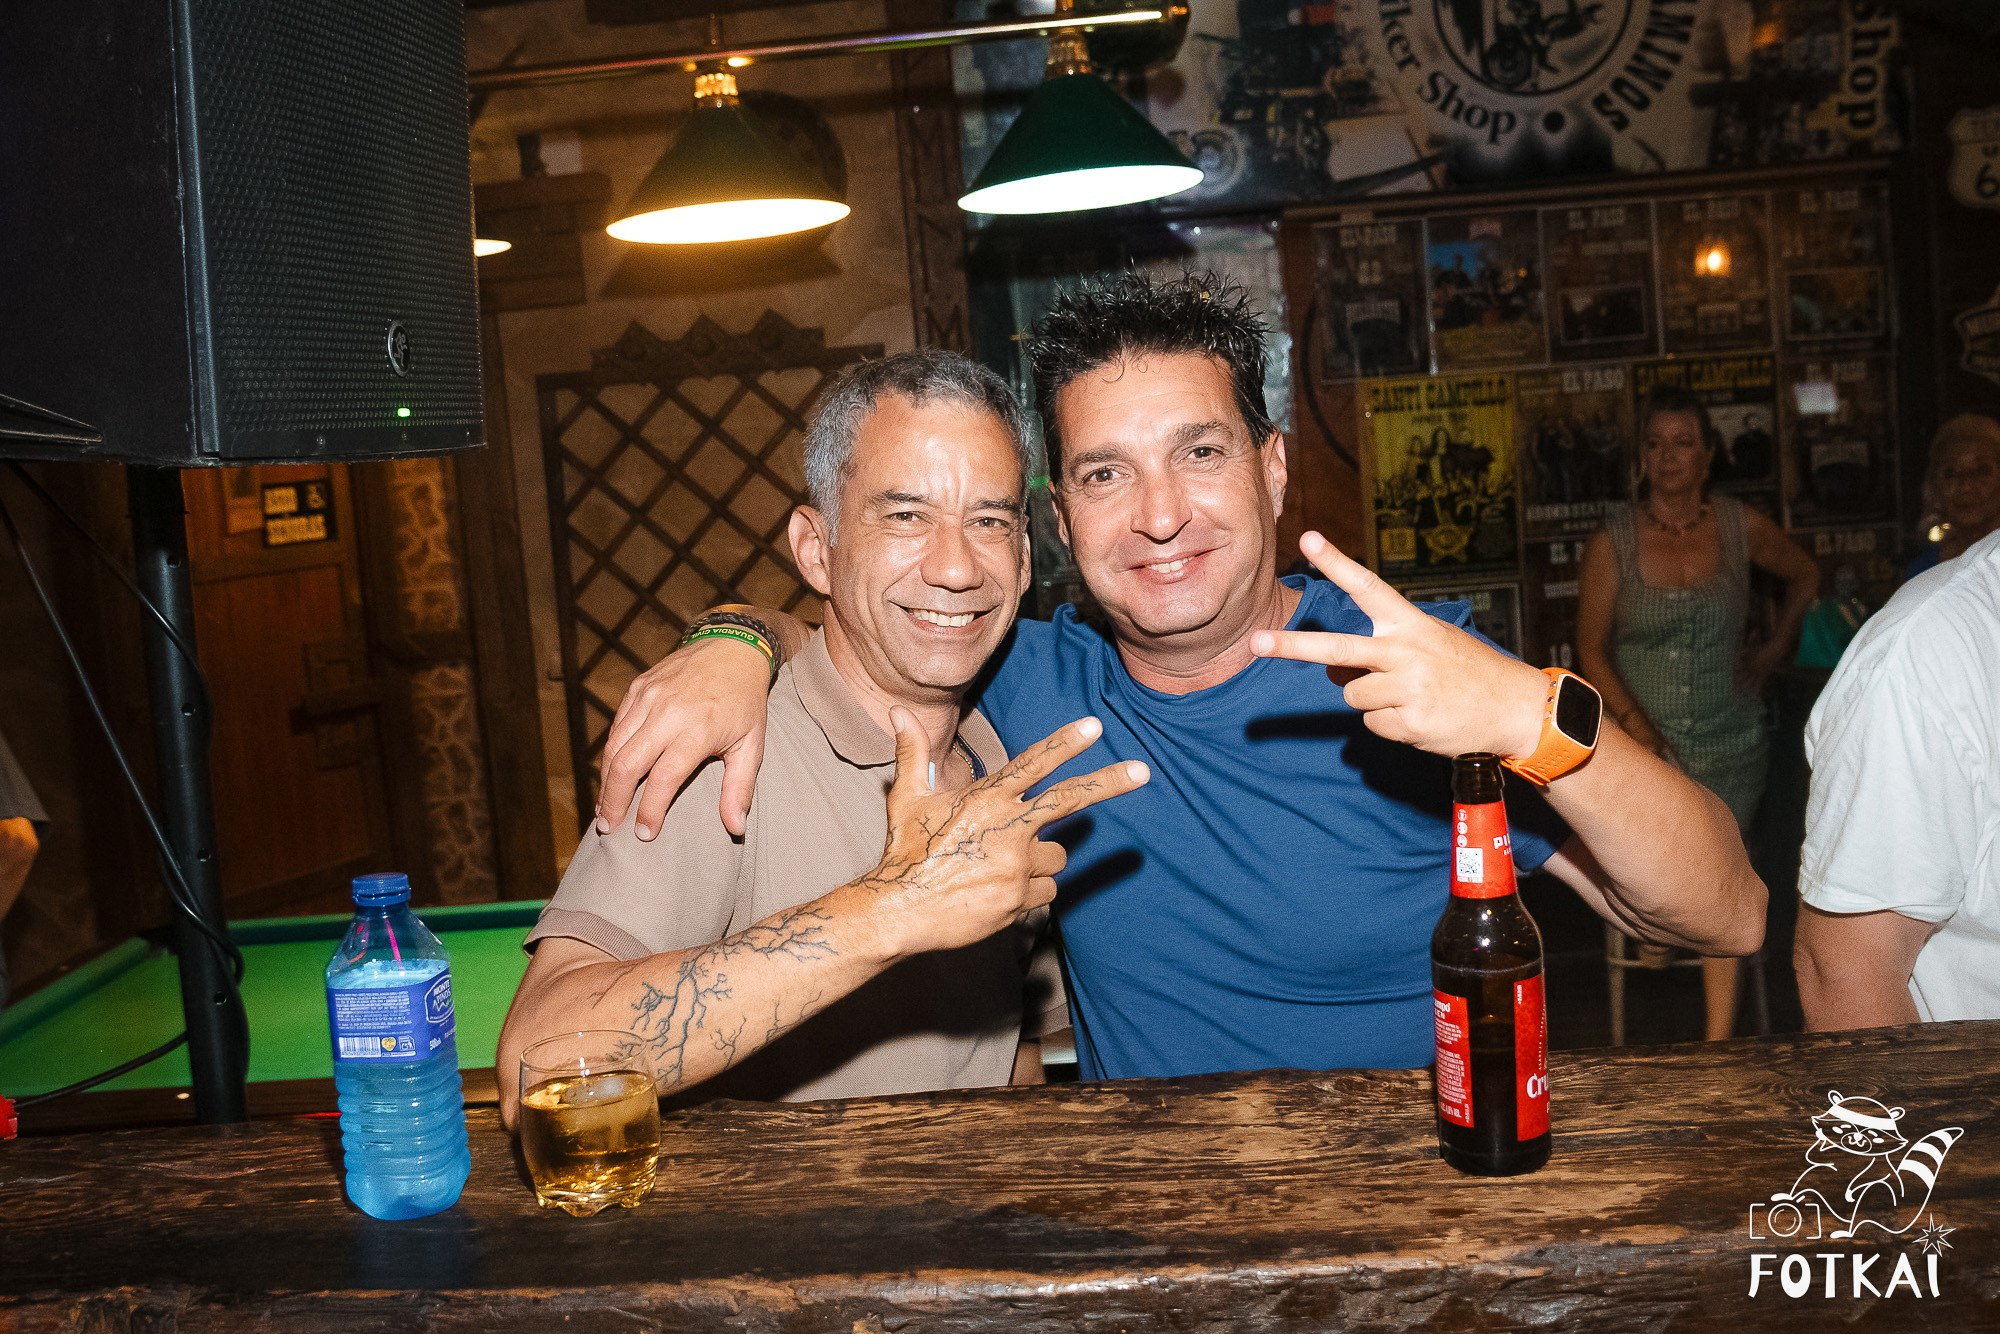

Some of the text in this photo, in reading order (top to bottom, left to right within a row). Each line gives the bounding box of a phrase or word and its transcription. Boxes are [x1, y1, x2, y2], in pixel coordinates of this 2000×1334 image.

[1378, 0, 1421, 71] ker
[1418, 71, 1516, 144] Shop
[1592, 0, 1695, 132] MINOS
[1562, 372, 1581, 394] EL
[1583, 367, 1625, 392] PASO
[712, 627, 755, 641] GUARDIA
[433, 979, 451, 996] MONTE
[436, 987, 452, 1004] PINOS
